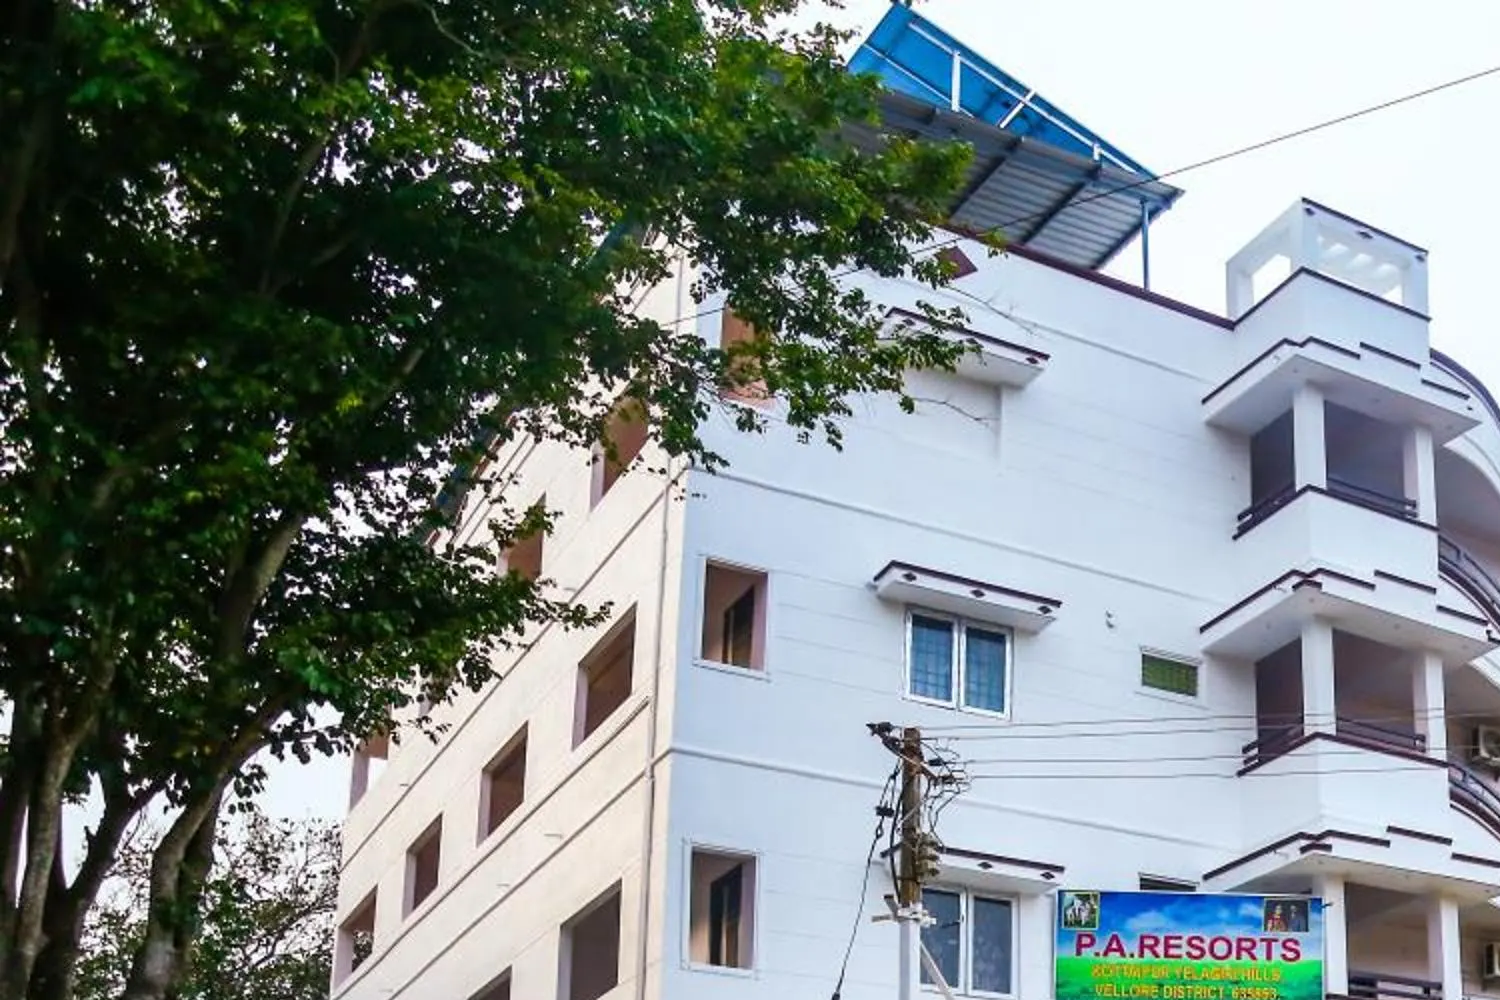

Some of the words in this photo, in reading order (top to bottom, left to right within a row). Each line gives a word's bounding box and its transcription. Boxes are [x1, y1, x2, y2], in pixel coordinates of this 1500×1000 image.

[1074, 932, 1301, 963] P.A.RESORTS
[1095, 983, 1159, 999] VELLORE
[1163, 985, 1224, 1000] DISTRICT
